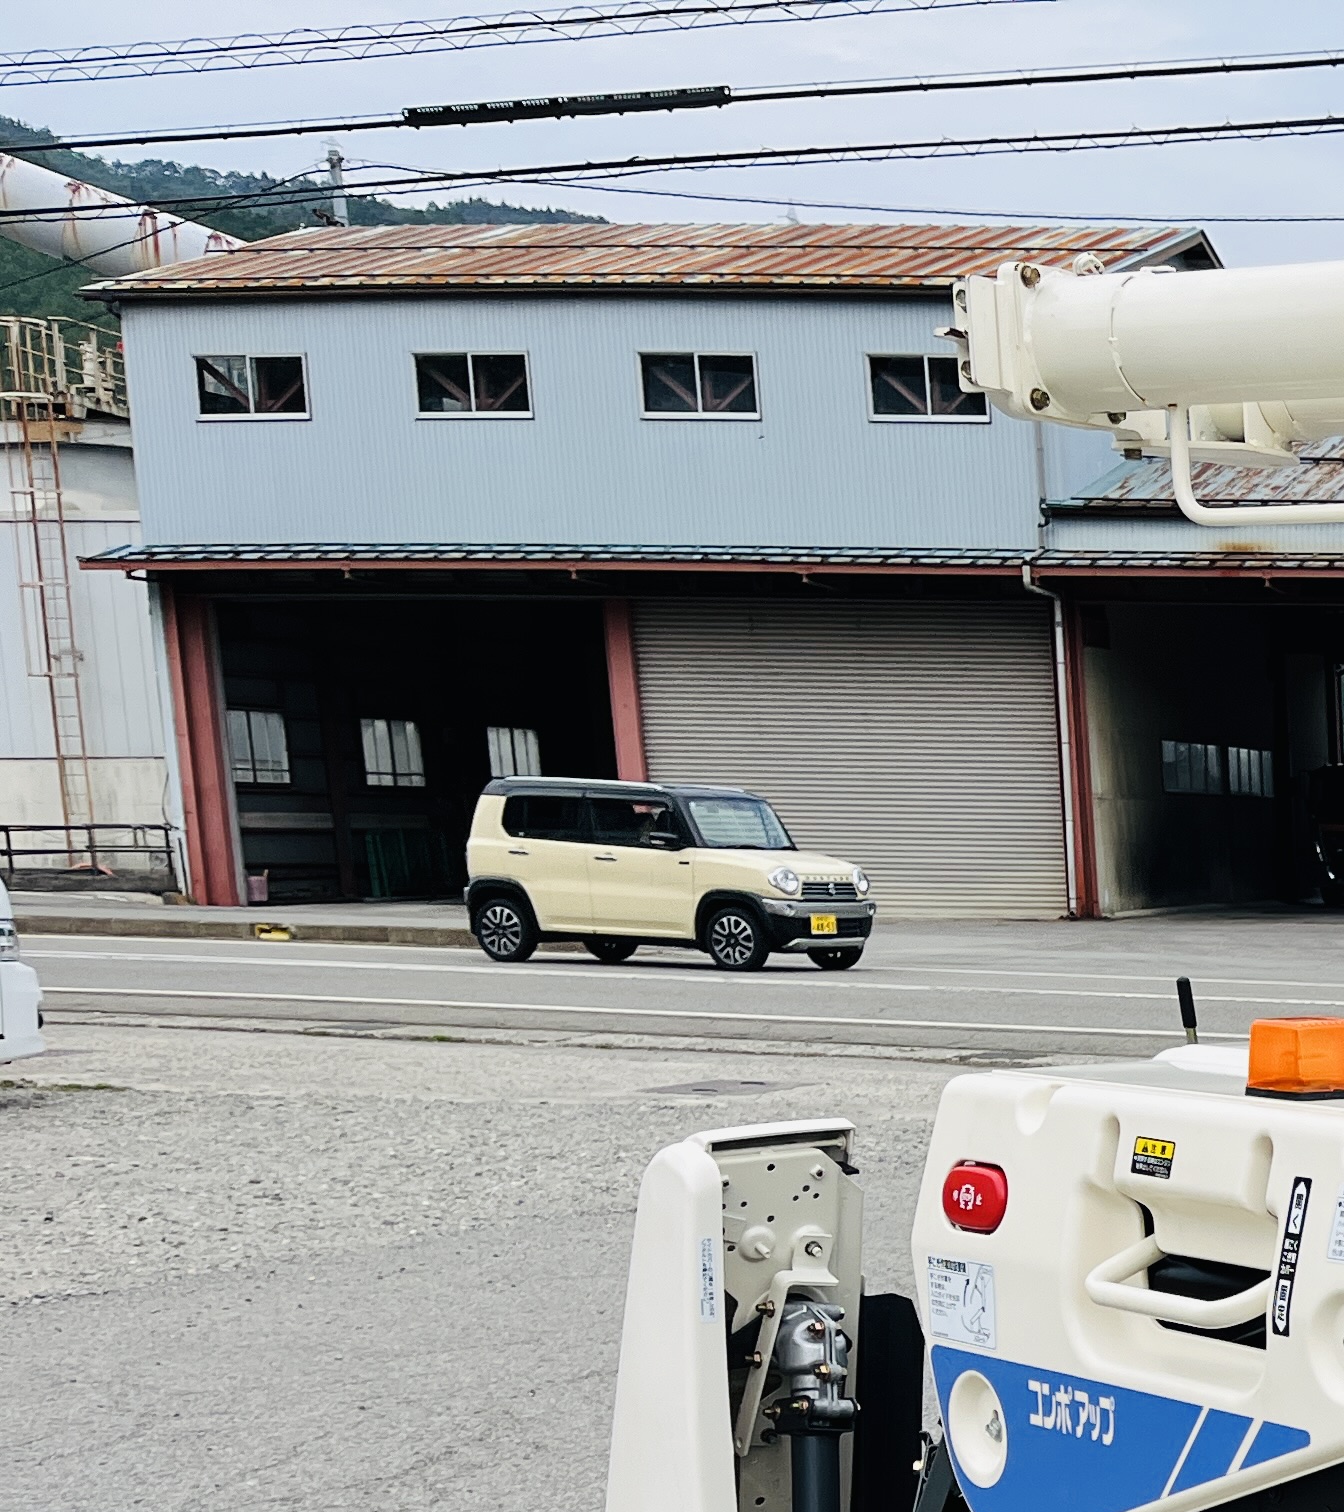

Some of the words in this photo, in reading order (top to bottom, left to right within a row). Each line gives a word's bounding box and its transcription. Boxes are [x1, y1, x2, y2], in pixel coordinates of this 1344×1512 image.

[1027, 1379, 1115, 1446] コンポアップ
